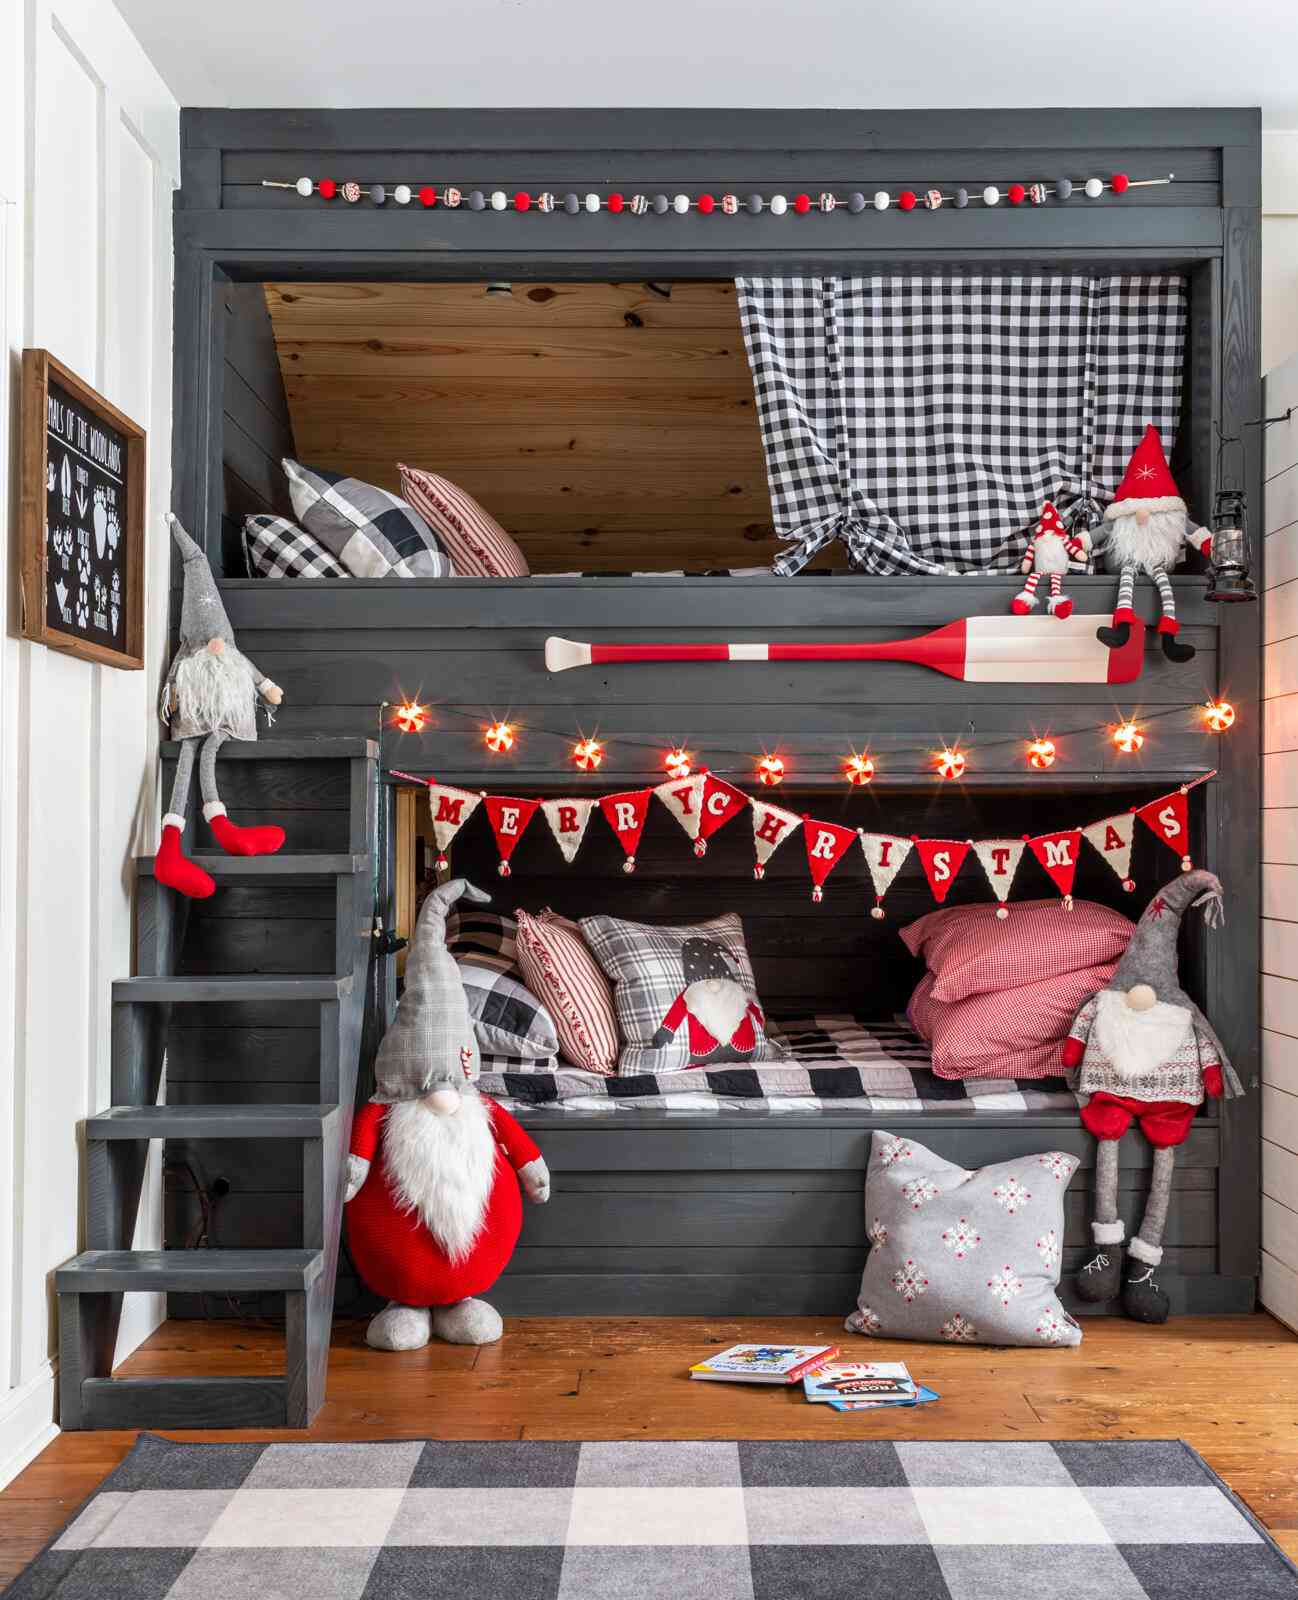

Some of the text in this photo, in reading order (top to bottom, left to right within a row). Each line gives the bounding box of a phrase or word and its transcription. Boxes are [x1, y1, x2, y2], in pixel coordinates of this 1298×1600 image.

[66, 409, 75, 441] OF
[77, 416, 88, 453] THE
[90, 425, 121, 474] WOODLANDS
[435, 786, 1181, 882] MERRY CHRISTMAS
[843, 1384, 899, 1394] FROSTY
